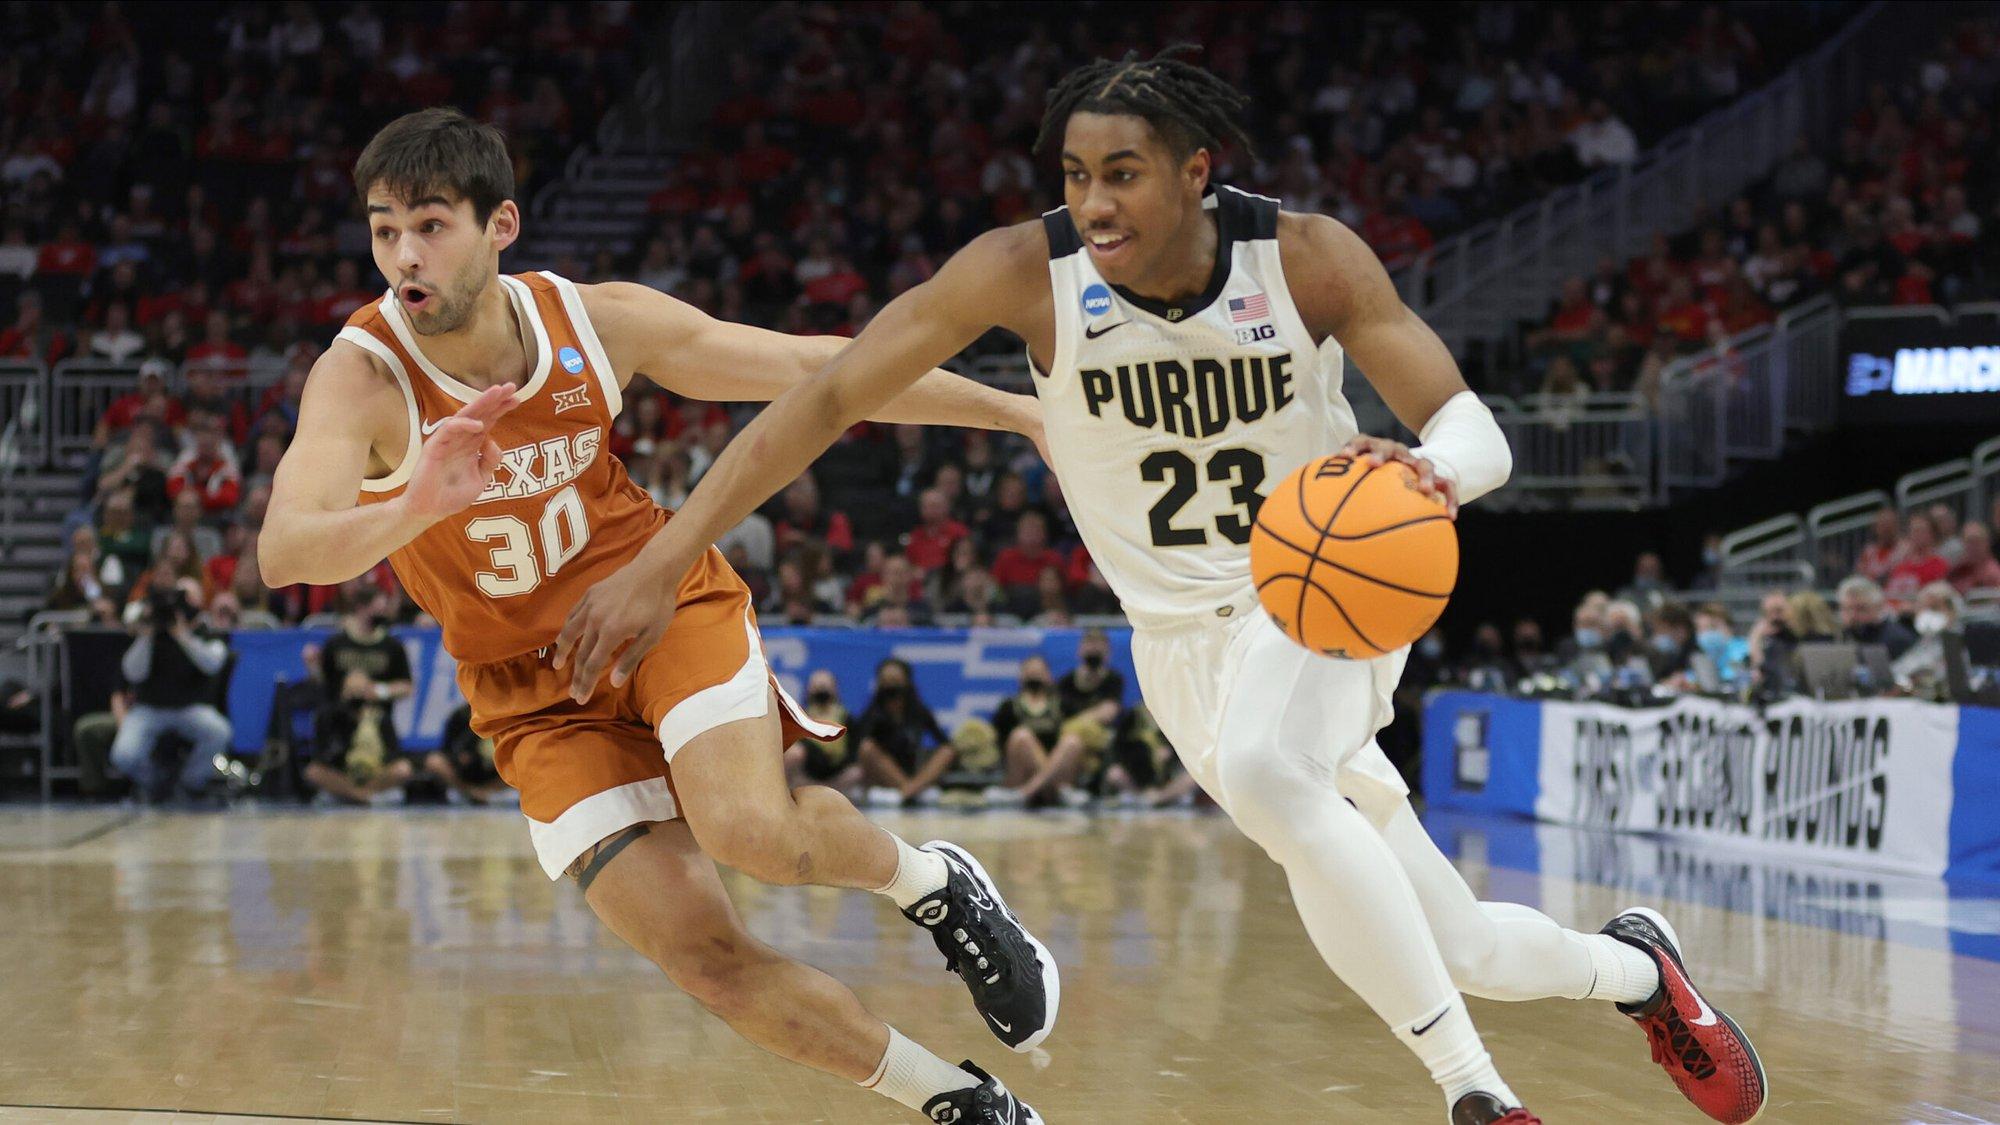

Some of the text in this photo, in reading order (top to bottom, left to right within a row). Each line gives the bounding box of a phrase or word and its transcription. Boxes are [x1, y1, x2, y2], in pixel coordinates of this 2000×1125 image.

[1080, 353, 1295, 438] PURDUE
[472, 427, 601, 505] XAS
[1140, 448, 1267, 546] 23
[465, 483, 590, 598] 30
[1763, 716, 1889, 850] ROUNDS
